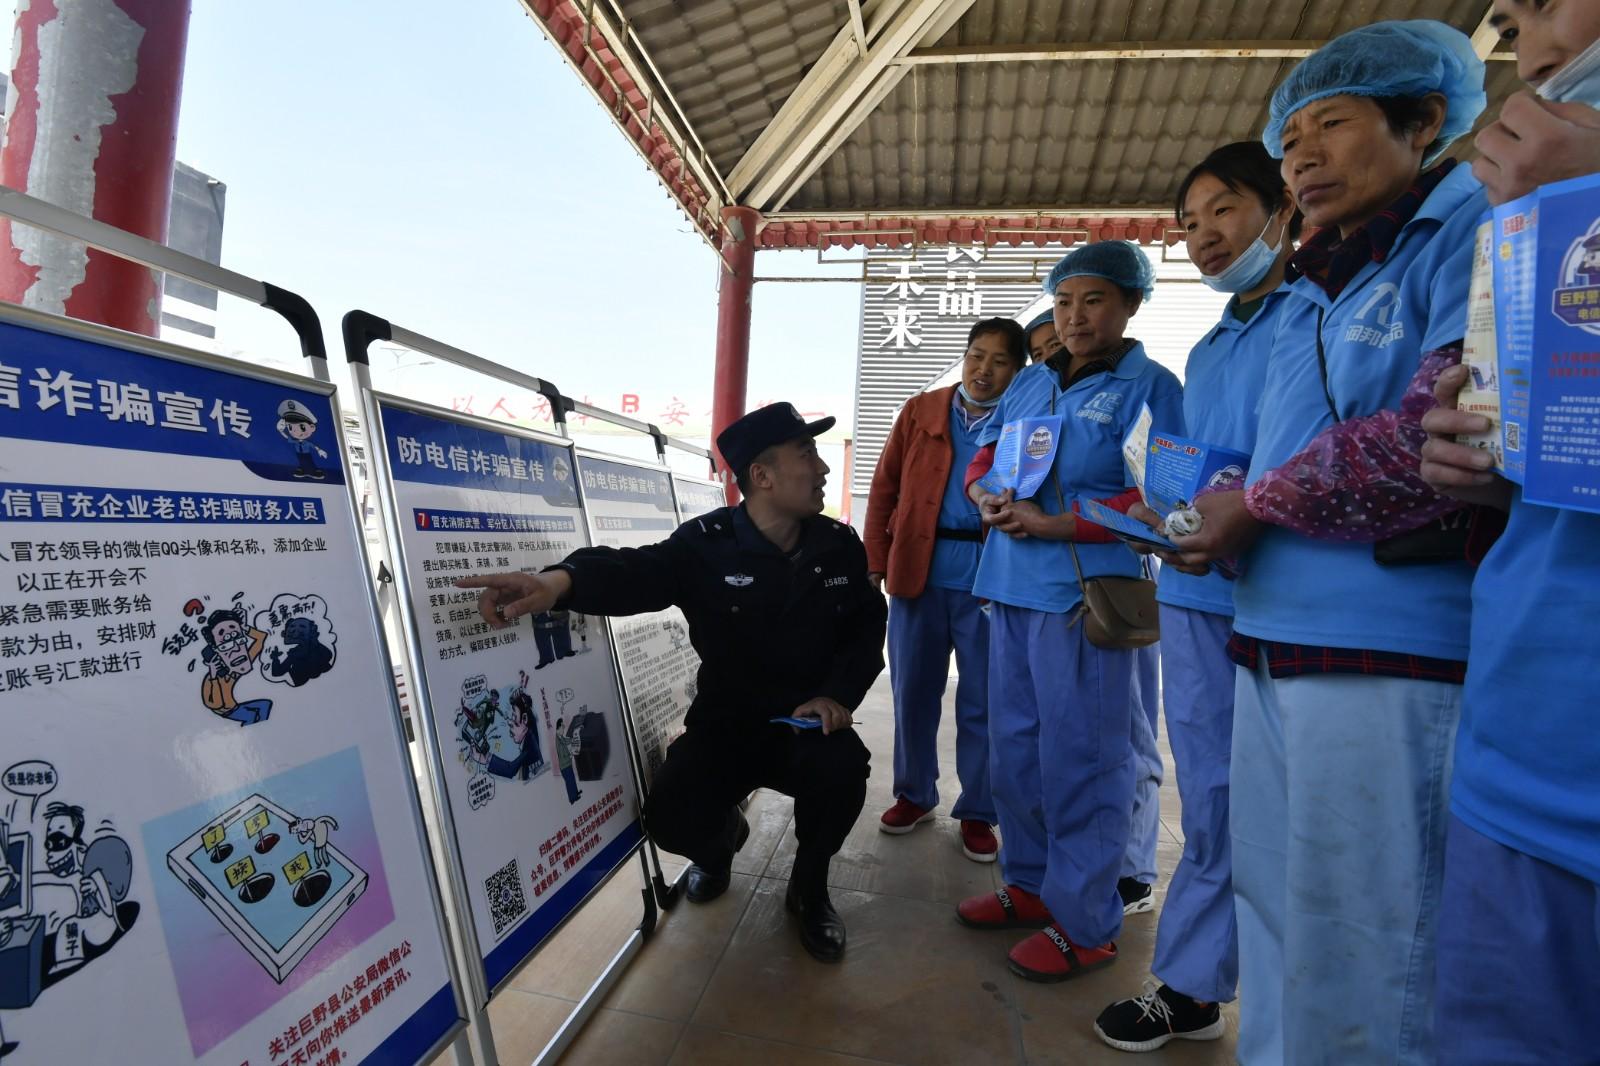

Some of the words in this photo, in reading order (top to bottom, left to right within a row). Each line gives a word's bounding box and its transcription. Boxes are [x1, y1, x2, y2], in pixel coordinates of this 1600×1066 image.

[396, 436, 545, 482] 防电信诈骗宣传
[583, 469, 656, 495] 防电信诈骗宣传
[2, 489, 319, 521] 信冒充企业老总诈骗财务人员
[17, 567, 147, 593] 以正在开会不
[0, 594, 152, 627] 紧急需要账务给
[7, 771, 54, 786] 我是你老板
[65, 923, 79, 957] 骗子
